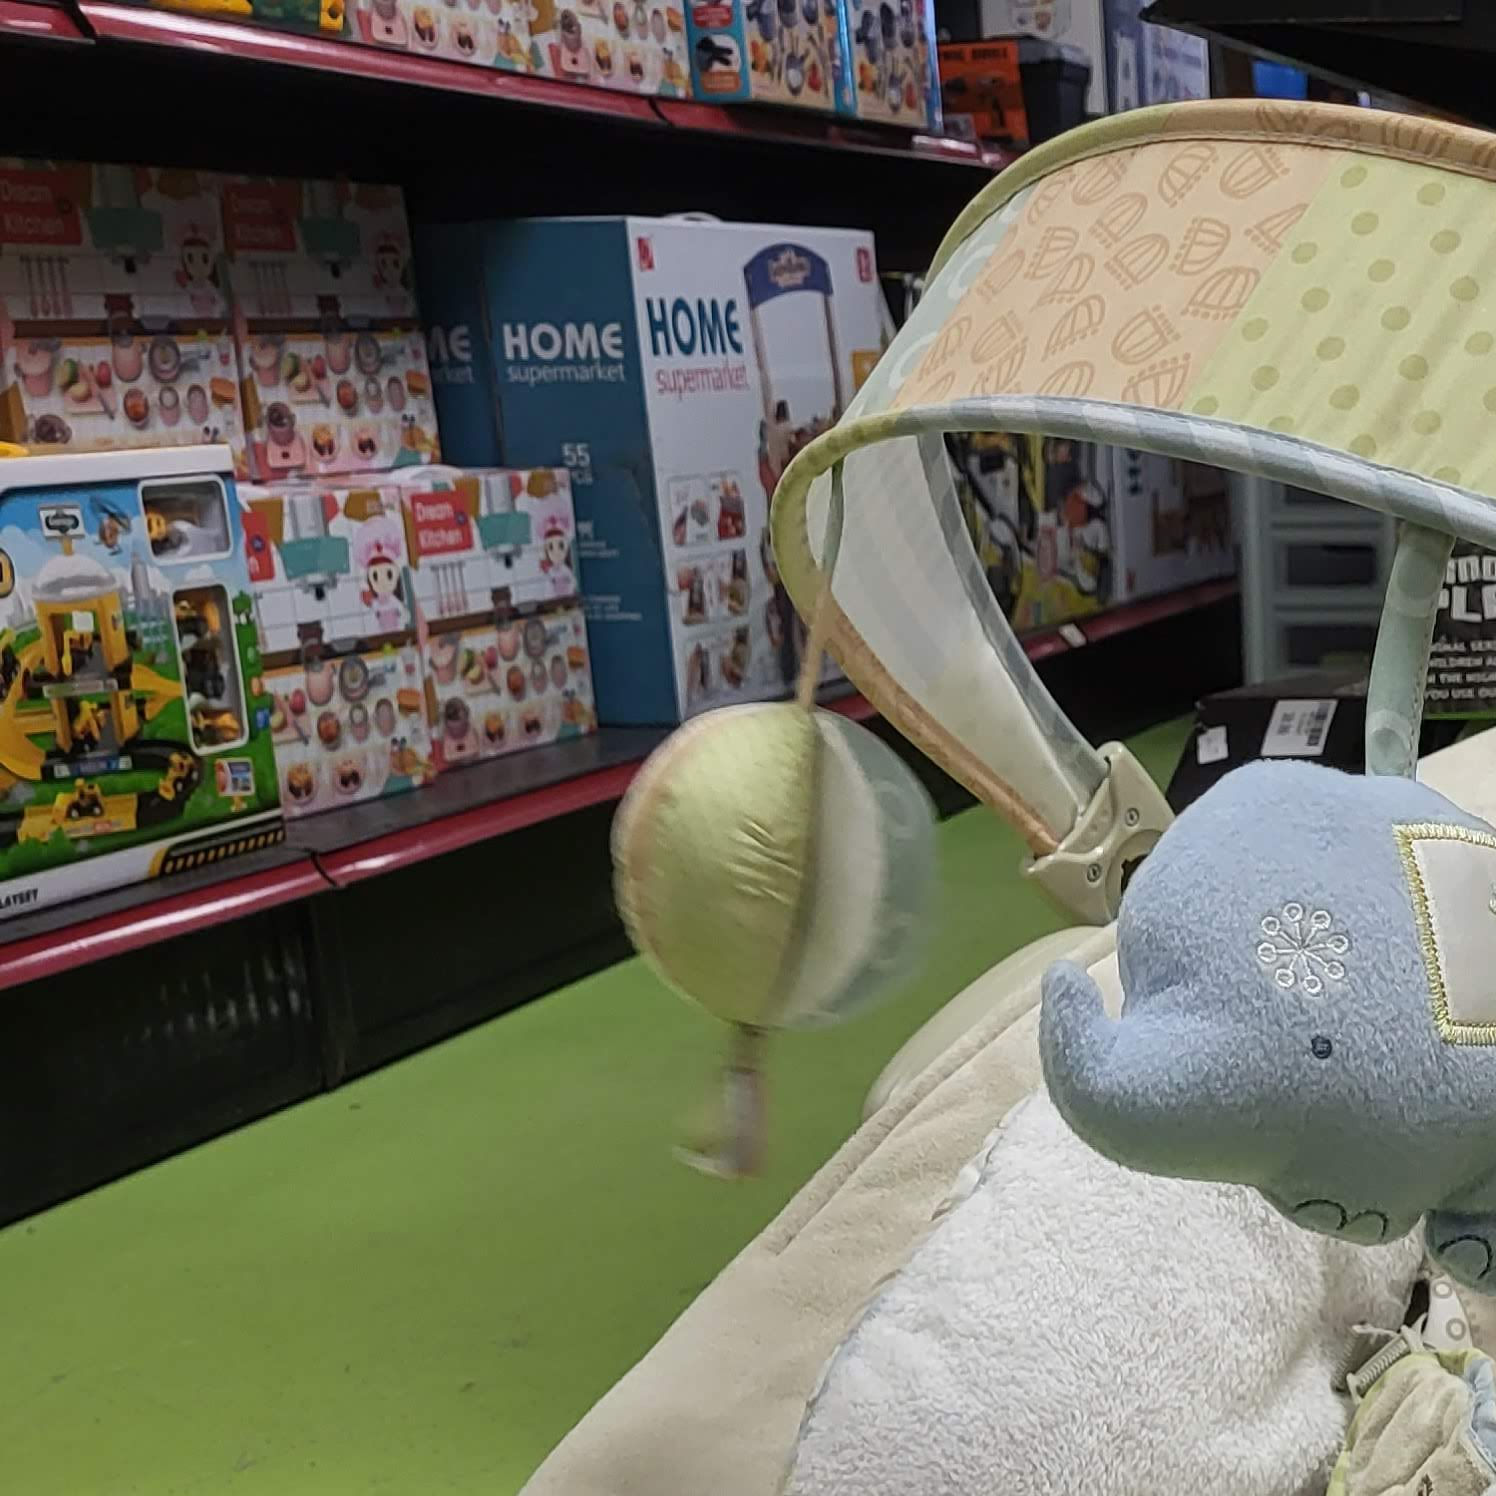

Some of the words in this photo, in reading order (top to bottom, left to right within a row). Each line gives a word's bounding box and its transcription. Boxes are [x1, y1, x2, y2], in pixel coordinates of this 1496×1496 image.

[422, 325, 472, 362] ME
[503, 322, 625, 361] HOME
[645, 297, 743, 356] HOME
[507, 361, 625, 387] supermarket
[656, 358, 749, 399] supermarket
[562, 443, 591, 467] 55
[418, 528, 464, 549] Kitchen
